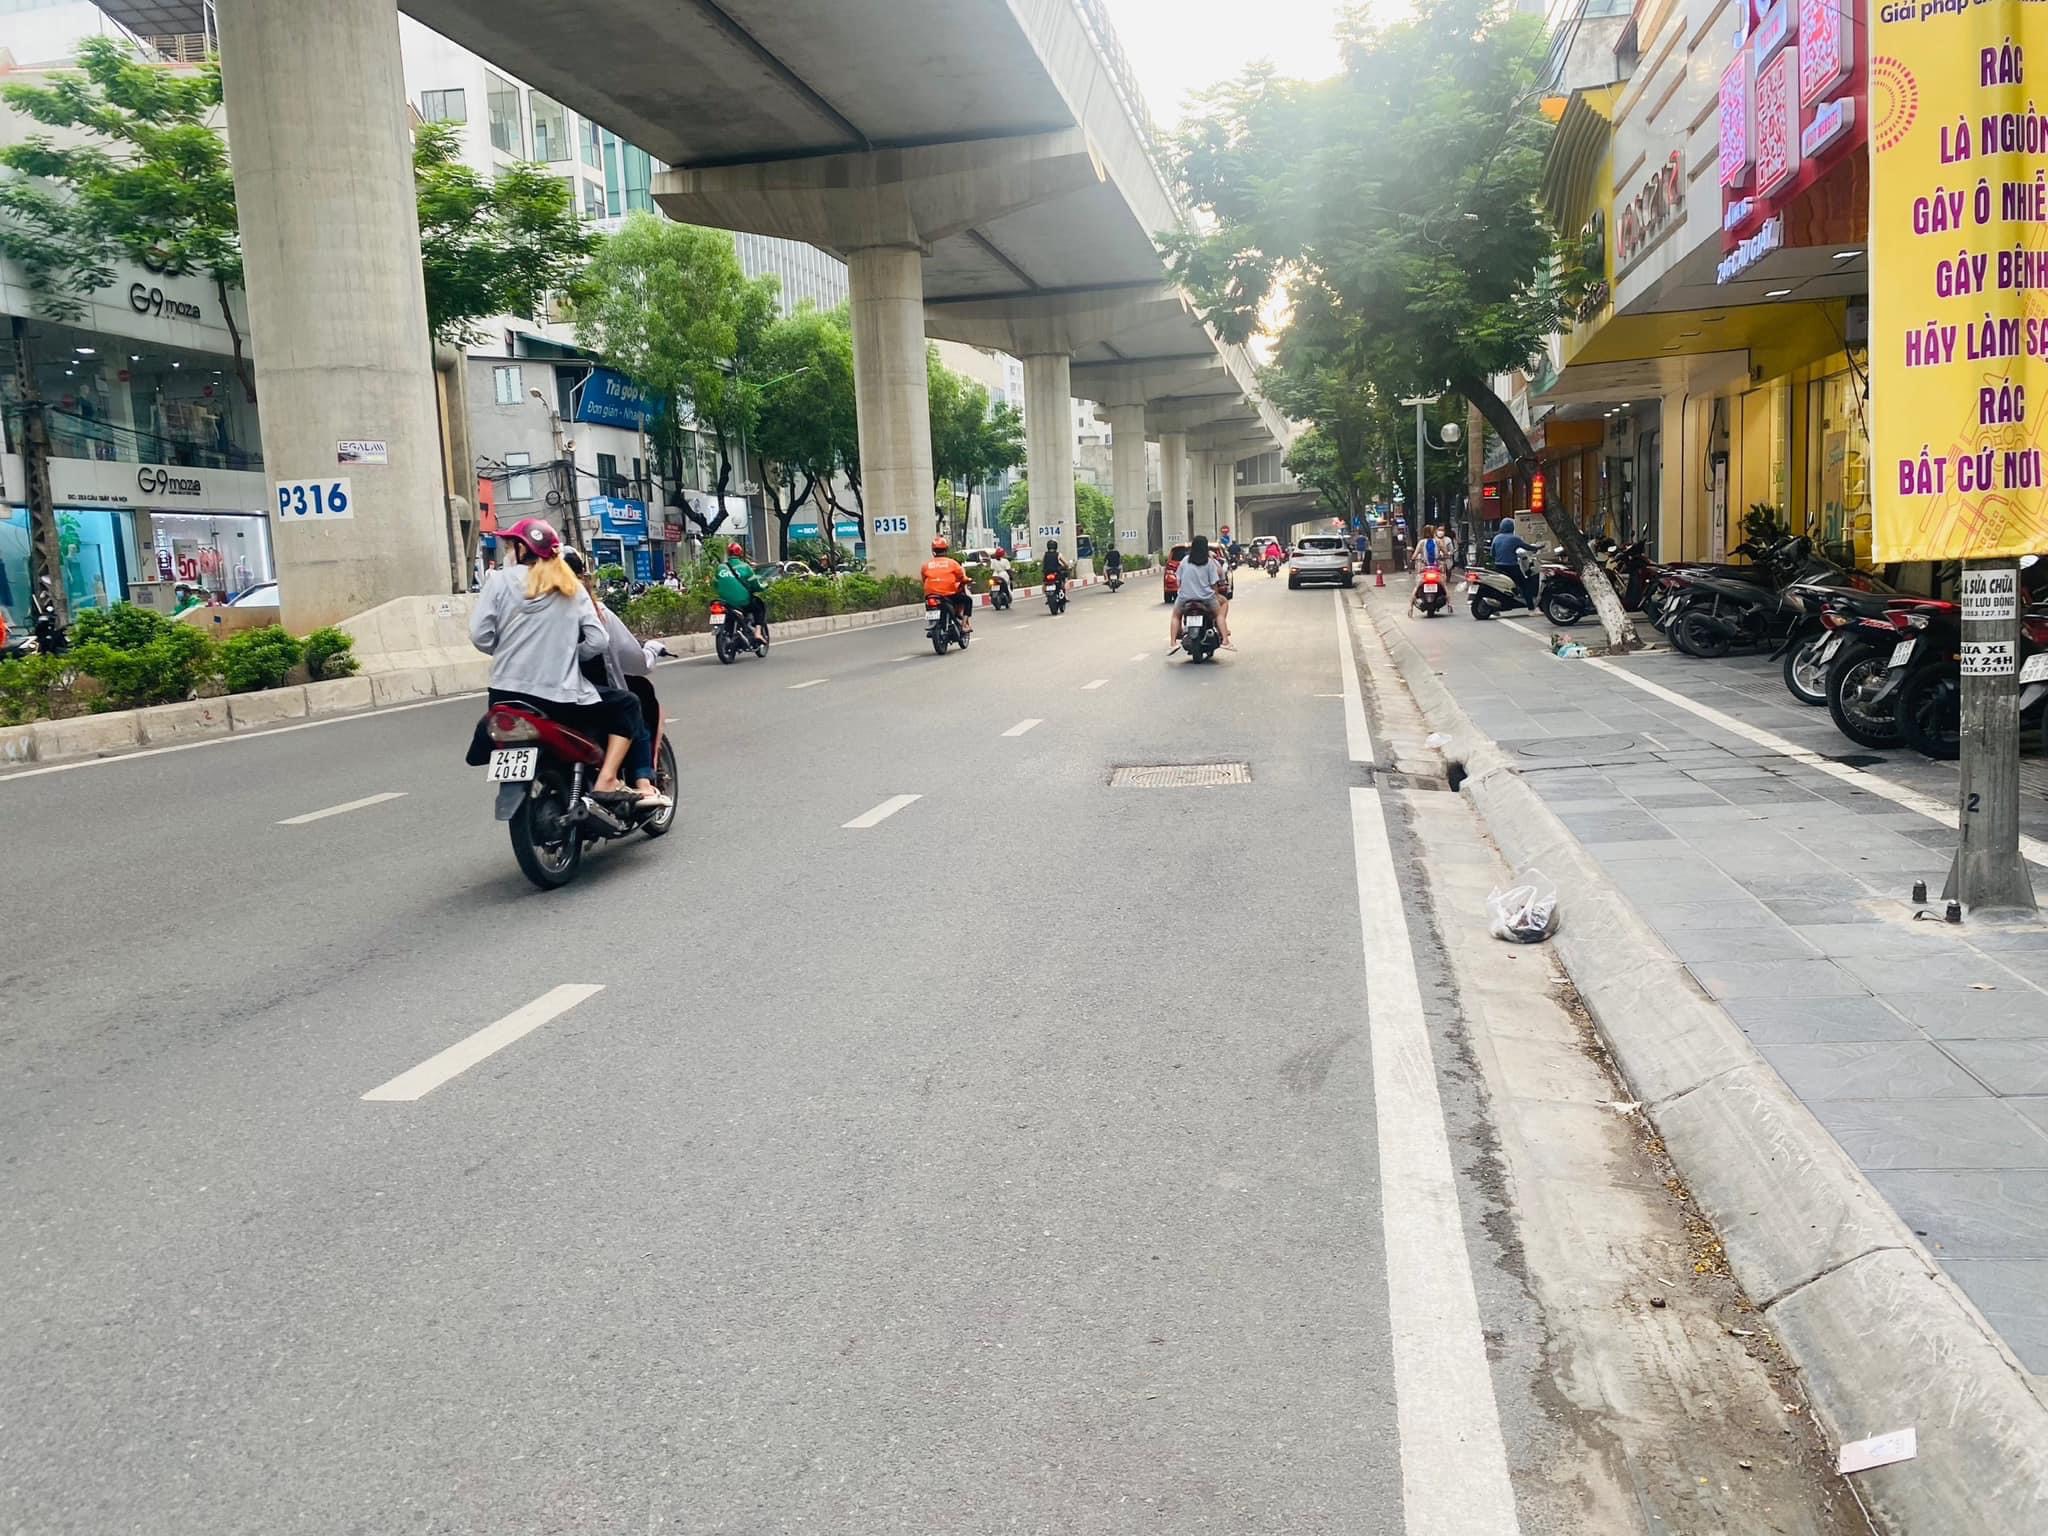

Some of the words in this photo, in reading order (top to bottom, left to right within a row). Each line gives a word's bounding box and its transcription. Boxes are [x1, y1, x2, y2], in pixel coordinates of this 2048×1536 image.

[1881, 0, 1916, 23] Giải
[1981, 36, 2024, 87] RÁC
[1941, 115, 1971, 164] LÀ
[1913, 186, 1965, 235] GÂY
[1974, 178, 1990, 224] Ô
[2002, 169, 2046, 221] NHIỄ
[1936, 249, 1987, 298] GÂY
[1998, 242, 2048, 297] BỆNH
[1905, 320, 1957, 367] HÃY
[1967, 312, 2020, 361] LÀM
[1979, 377, 2025, 425] RÁC
[1899, 444, 1947, 495] BẤT
[1957, 446, 1995, 492] CỨ
[2004, 448, 2042, 489] NƠI
[278, 483, 348, 517] P316
[875, 518, 907, 533] P315
[1039, 527, 1061, 536] P314
[1969, 573, 1986, 594] SỬA
[1990, 574, 2013, 594] CHỮA
[1982, 656, 2013, 665] 24H
[1987, 645, 2007, 654] XE
[497, 750, 530, 765] 24-P5
[495, 765, 527, 778] 4048
[1967, 792, 1980, 813] 2
